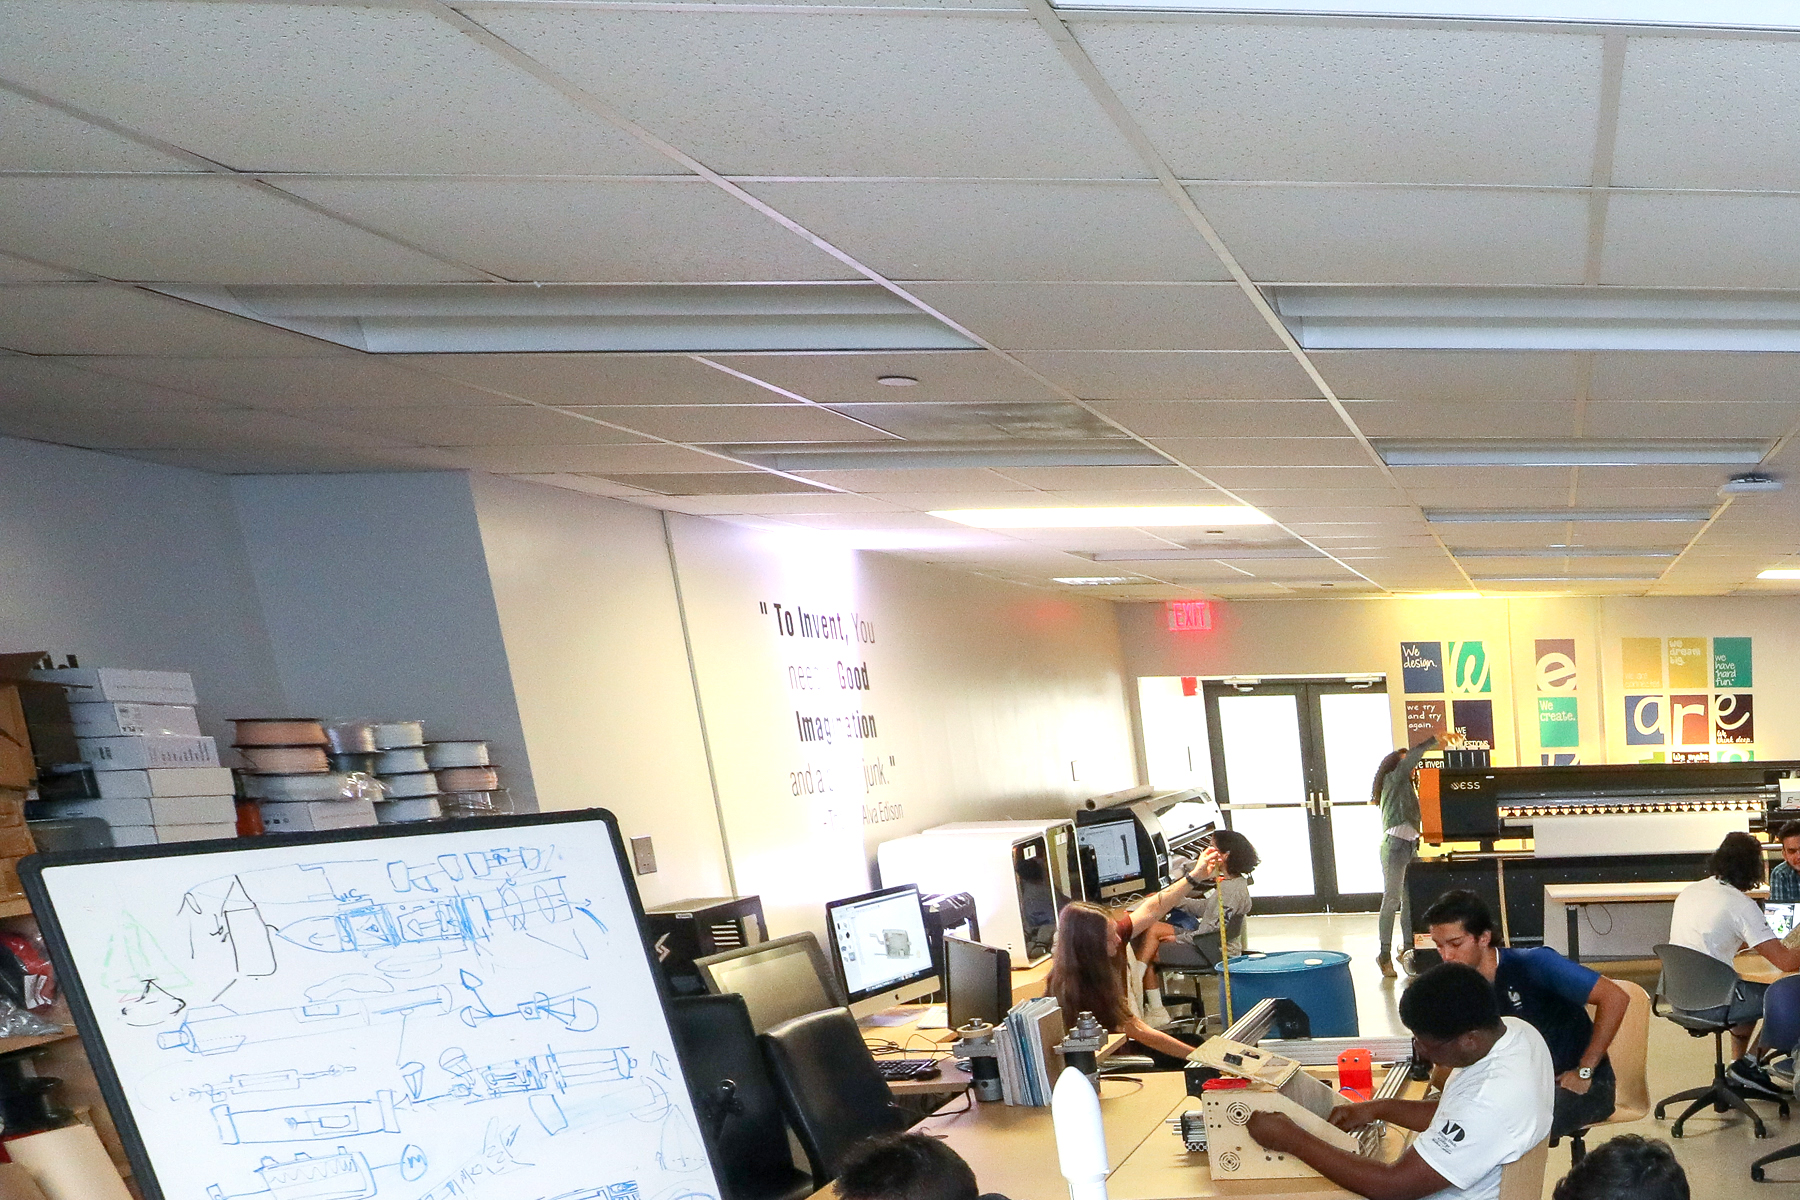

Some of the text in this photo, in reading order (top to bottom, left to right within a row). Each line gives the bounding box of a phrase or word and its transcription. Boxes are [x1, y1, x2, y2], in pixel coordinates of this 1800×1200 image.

[1173, 602, 1205, 627] EXIT
[773, 603, 794, 637] To
[797, 606, 849, 646] Invent,
[851, 612, 876, 644] You
[1402, 644, 1420, 657] We
[1403, 657, 1438, 671] design.
[1714, 654, 1727, 662] we
[1715, 661, 1736, 670] have
[788, 660, 870, 691] nee Good
[1423, 704, 1436, 713] try
[1539, 700, 1554, 711] We
[1408, 711, 1442, 722] and try
[1540, 710, 1576, 722] create.
[795, 710, 878, 745] Imagation
[1408, 722, 1434, 732] again.
[1455, 726, 1467, 735] WE
[789, 762, 815, 797] and
[862, 804, 879, 826] Alva
[878, 801, 904, 823] Edison
